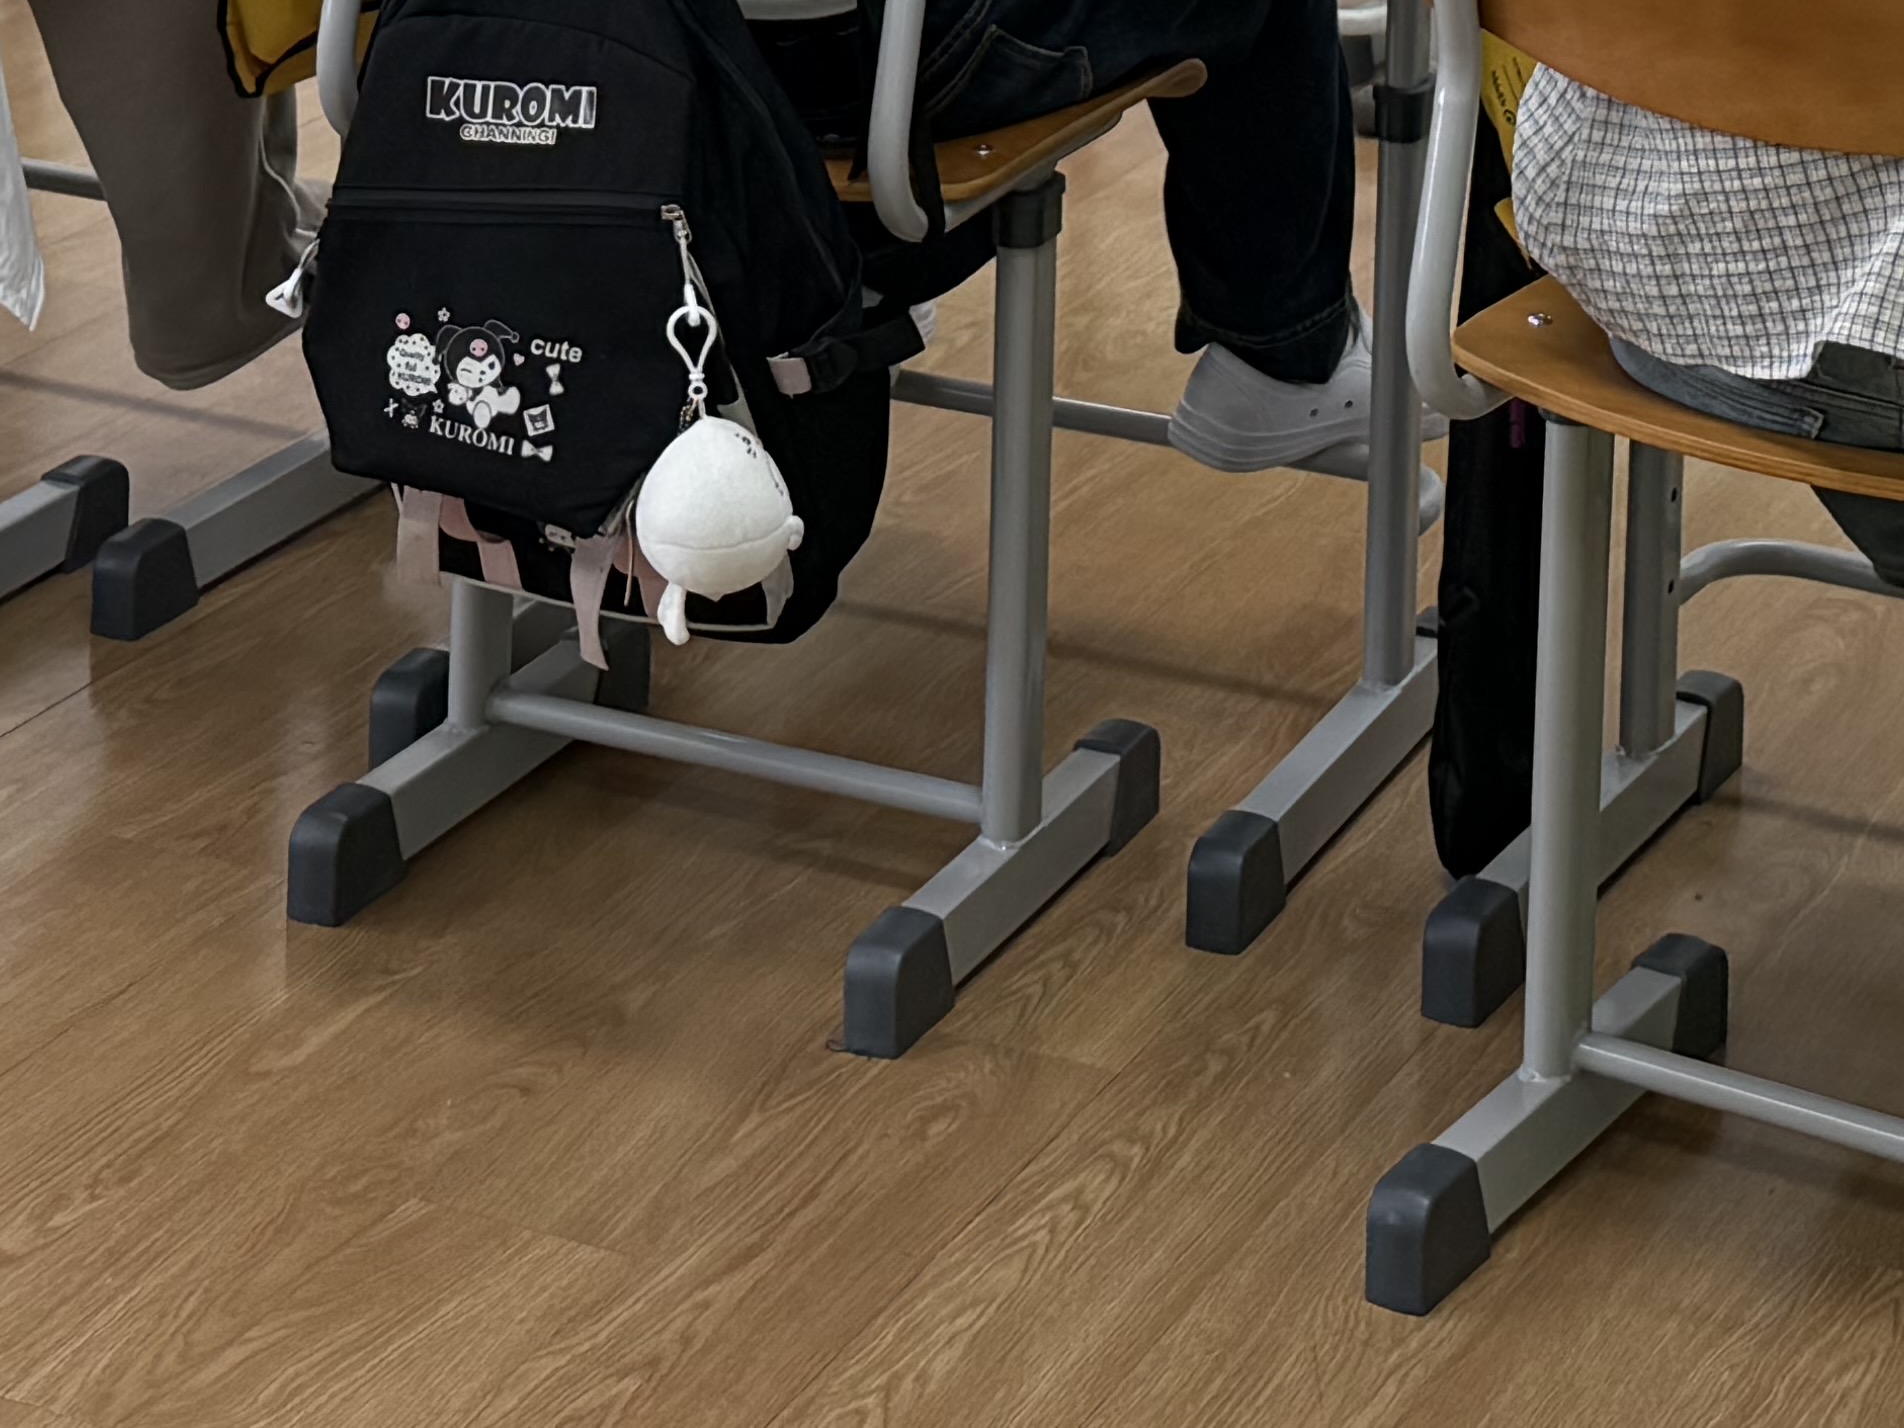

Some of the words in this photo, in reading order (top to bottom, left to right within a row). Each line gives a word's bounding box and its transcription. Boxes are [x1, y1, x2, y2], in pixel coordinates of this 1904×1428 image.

[425, 75, 598, 129] KUROMI
[529, 338, 583, 363] cute
[428, 414, 516, 456] KUROMI
